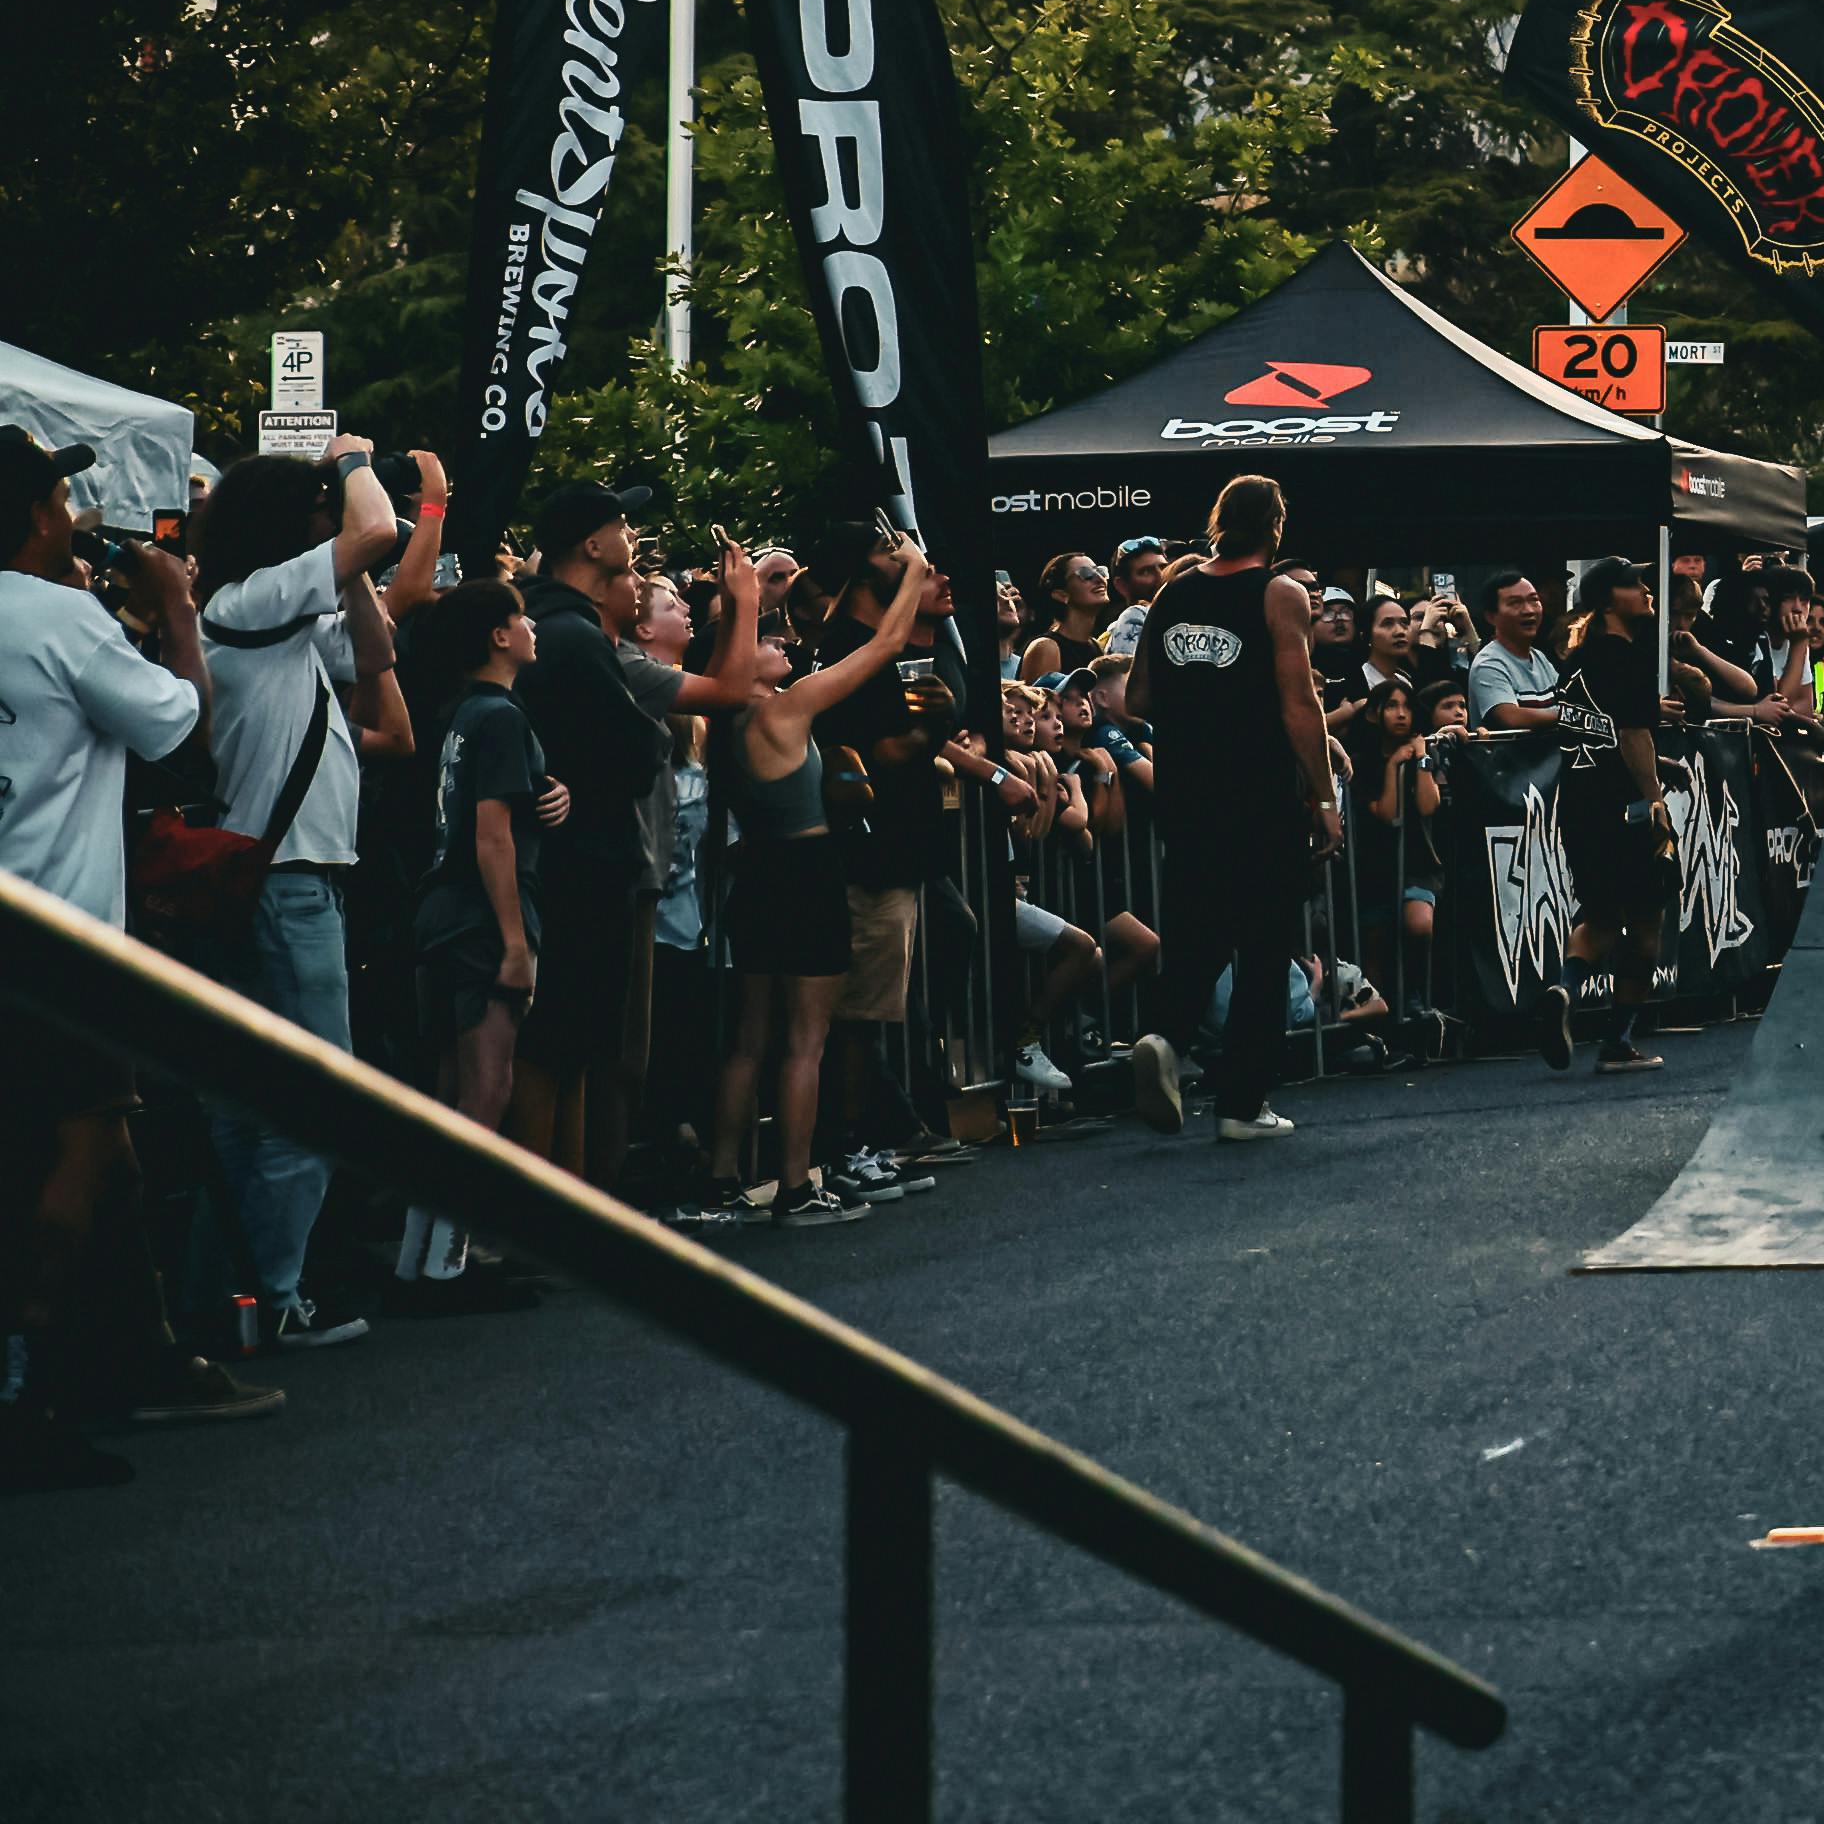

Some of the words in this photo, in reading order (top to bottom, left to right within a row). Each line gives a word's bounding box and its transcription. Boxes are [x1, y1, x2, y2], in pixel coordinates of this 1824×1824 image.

[1642, 122, 1745, 214] PROJECTS
[490, 223, 530, 375] BREWING
[281, 351, 313, 373] 4P
[1563, 333, 1638, 378] 20
[1668, 345, 1707, 359] MORT
[264, 415, 332, 427] ATTENTION
[480, 384, 507, 439] CO.
[1160, 410, 1400, 440] boost
[1200, 435, 1337, 448] mobile
